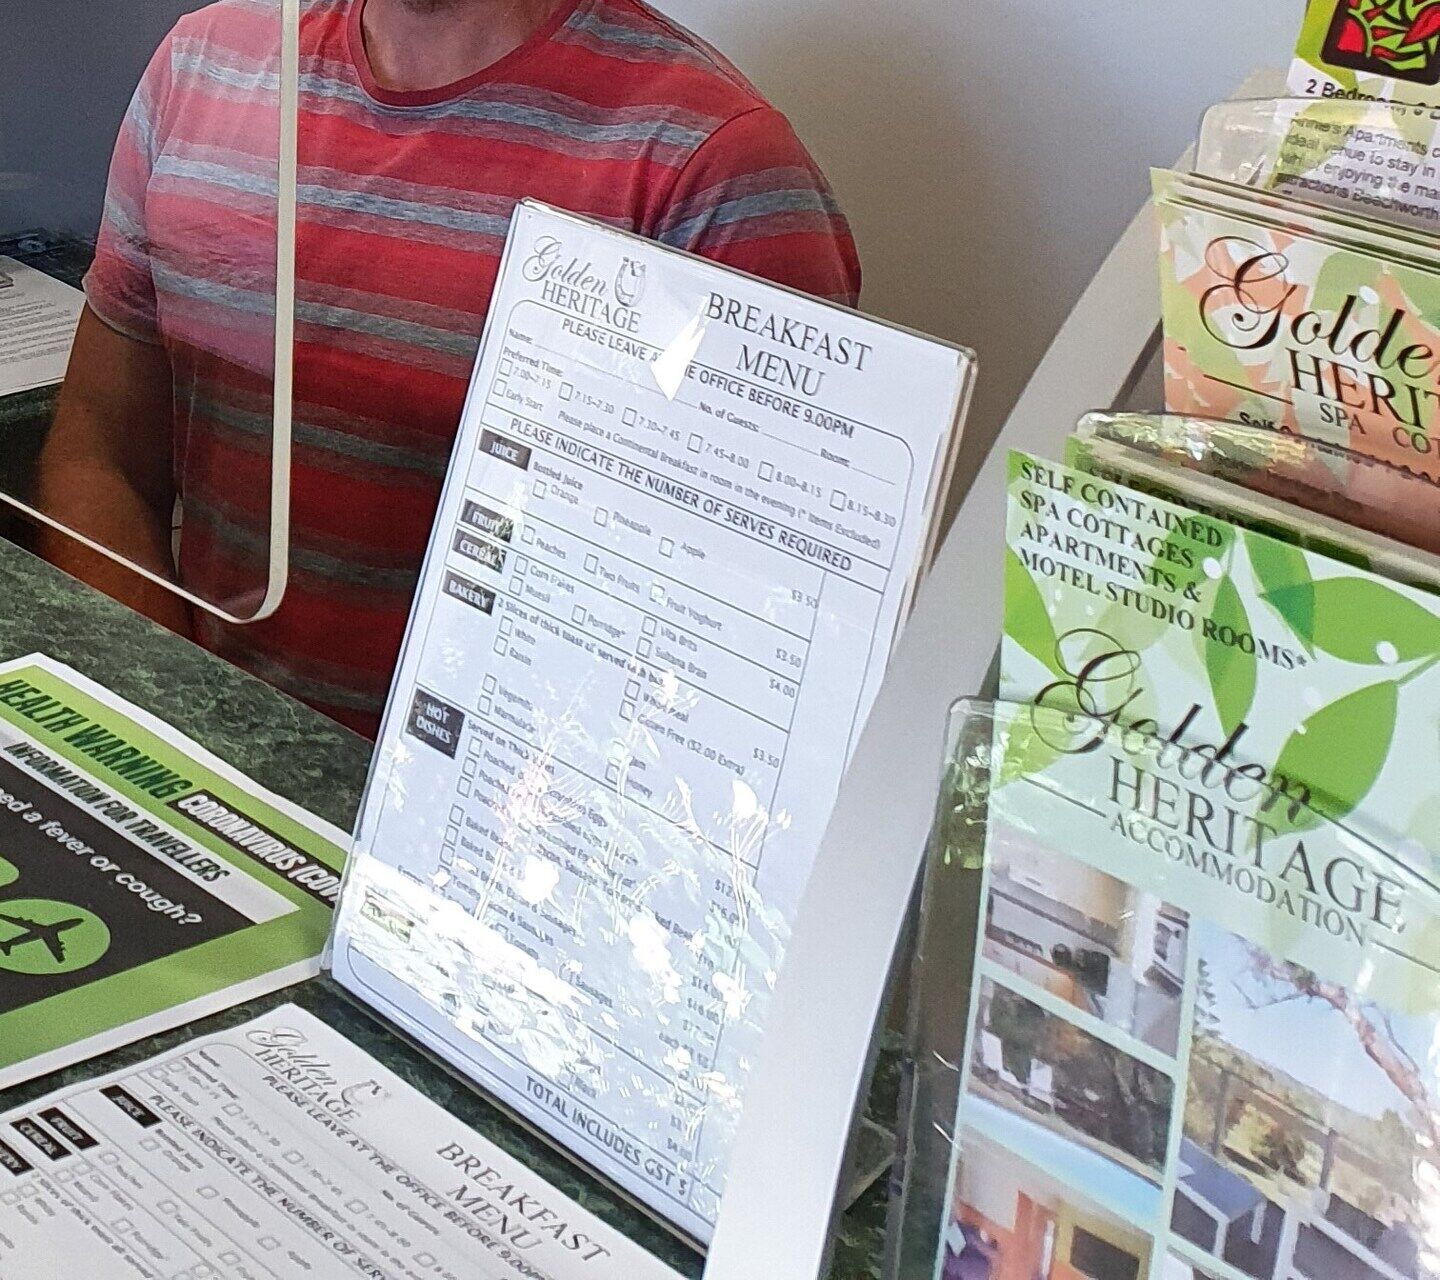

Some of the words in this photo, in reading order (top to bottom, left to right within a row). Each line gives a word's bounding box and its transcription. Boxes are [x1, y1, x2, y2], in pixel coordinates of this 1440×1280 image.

[1306, 79, 1317, 94] 2
[1387, 158, 1419, 176] stay
[1422, 165, 1435, 177] in
[522, 235, 607, 297] Golden
[541, 279, 642, 333] HERITAGE
[562, 318, 607, 345] PLEASE
[608, 336, 648, 361] LEAVE
[705, 291, 872, 372] BREAKFAST
[1199, 235, 1440, 378] Golde
[699, 370, 745, 398] OFFICE
[748, 388, 801, 418] BEFORE
[803, 408, 855, 439] 9.00PM
[735, 344, 826, 397] MENU
[1319, 402, 1366, 434] SPA
[510, 418, 554, 446] PLEASE
[555, 437, 615, 471] INDICATE
[618, 461, 641, 484] THE
[644, 474, 700, 509] NUMBER
[703, 498, 724, 518] OF
[724, 507, 775, 540] SERVES
[777, 530, 852, 572] REQUIRED
[1020, 460, 1076, 494] SELF
[1080, 482, 1223, 548] CONTAINED
[1020, 490, 1060, 521] SPA
[1067, 508, 1195, 569] COTTAGES
[1019, 548, 1102, 596] MOTEL
[1106, 581, 1195, 630] STUDIO
[1020, 522, 1178, 594] APARTMENTS
[1182, 580, 1202, 602] &
[416, 716, 452, 744] DISHES
[426, 701, 450, 723] HOT
[1028, 627, 1313, 823] Golden
[3, 741, 111, 804] INFORMATION
[93, 795, 139, 824] FOR
[124, 818, 230, 882] TRAVELLERS
[63, 724, 194, 800] WARNING
[177, 794, 307, 871] CORONAVIRUS
[22, 810, 43, 823] a
[39, 820, 95, 856] fever
[90, 855, 121, 872] or
[115, 872, 203, 925] cough?
[1107, 754, 1409, 935] HERITAGE
[1110, 812, 1369, 945] ACCOMMODATION
[245, 1026, 338, 1086] Golden
[255, 1048, 356, 1122] HERITAGE
[262, 1075, 309, 1108] PLEASE
[306, 1108, 350, 1138] LEAVE
[348, 1138, 372, 1153] AT
[368, 1152, 396, 1174] THE
[395, 1174, 446, 1210] OFFICE
[444, 1210, 498, 1250] BEFORE
[525, 1075, 569, 1119] TOTAL
[571, 1107, 643, 1167] INCLUDES
[644, 1158, 675, 1188] GST
[149, 1094, 195, 1128] PLEASE
[192, 1129, 253, 1176] INDICATE
[252, 1175, 279, 1196] THE
[279, 1196, 335, 1241] NUMBER
[332, 1239, 356, 1255] OF
[436, 1140, 612, 1262] BREAKFAST
[446, 1184, 543, 1250] MENU
